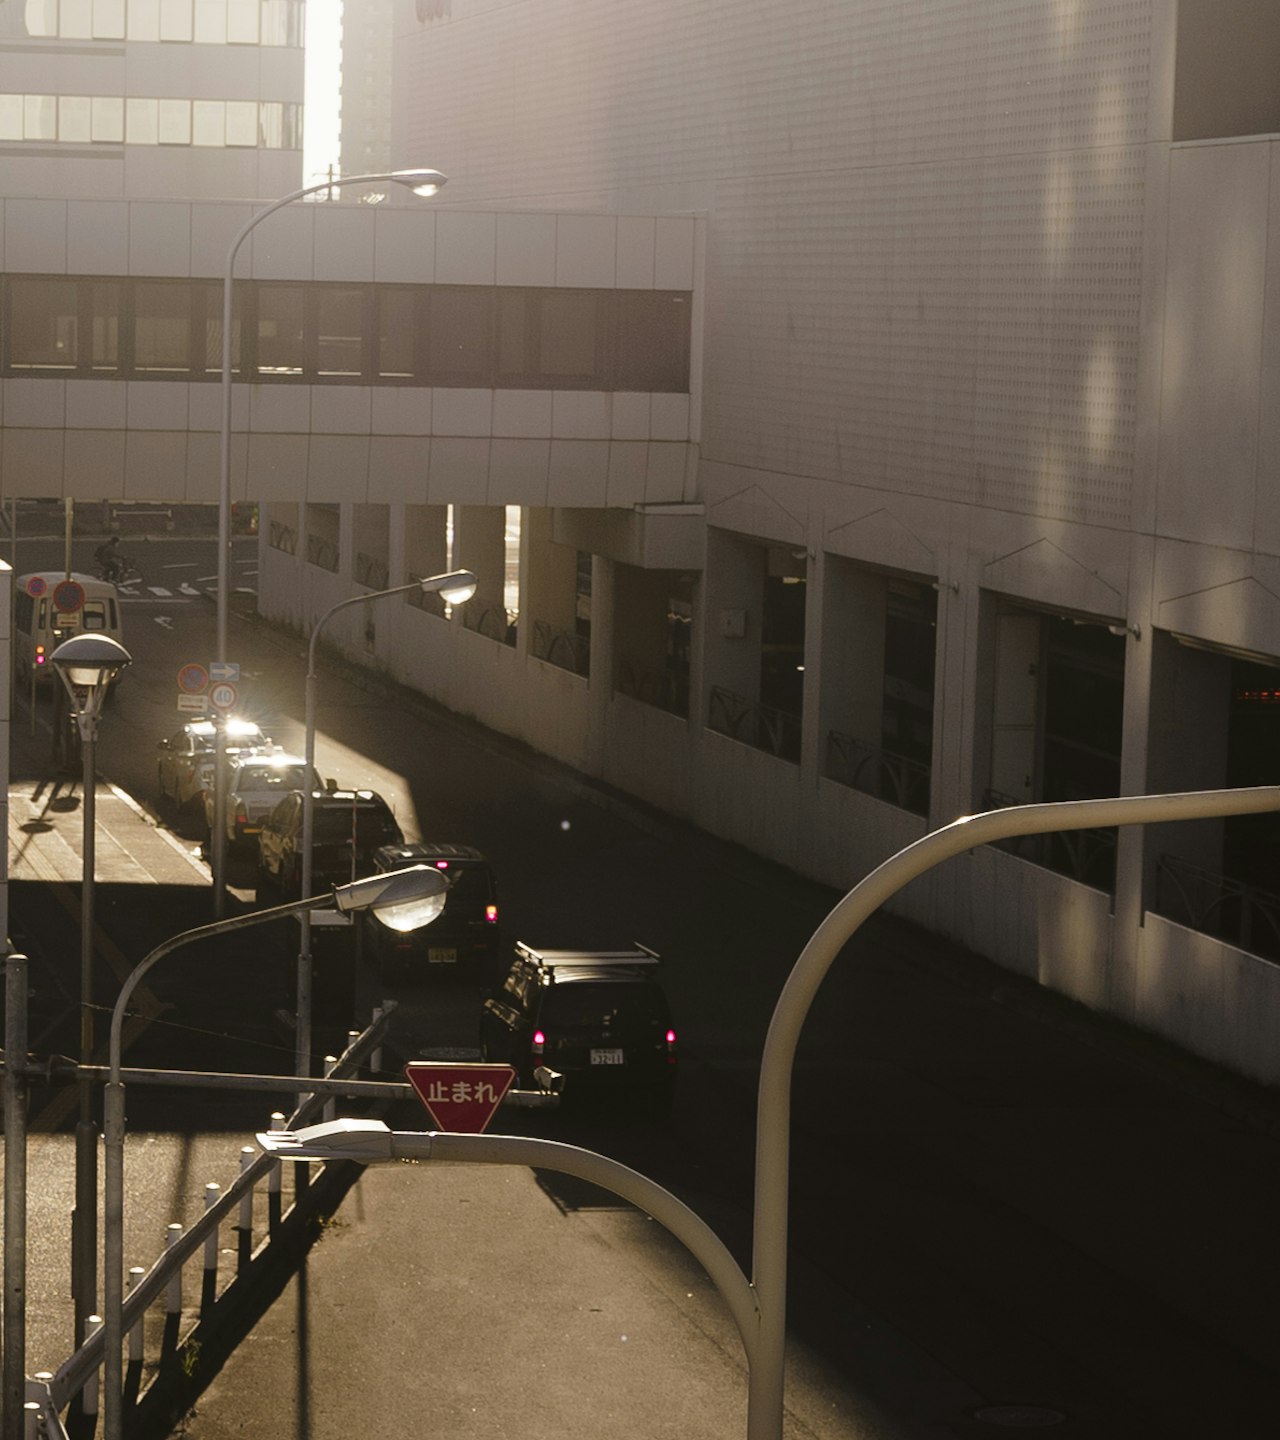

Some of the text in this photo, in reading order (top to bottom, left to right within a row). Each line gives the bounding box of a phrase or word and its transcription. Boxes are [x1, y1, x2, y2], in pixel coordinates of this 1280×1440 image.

[215, 689, 232, 703] 40
[427, 1080, 499, 1104] 止まれ
